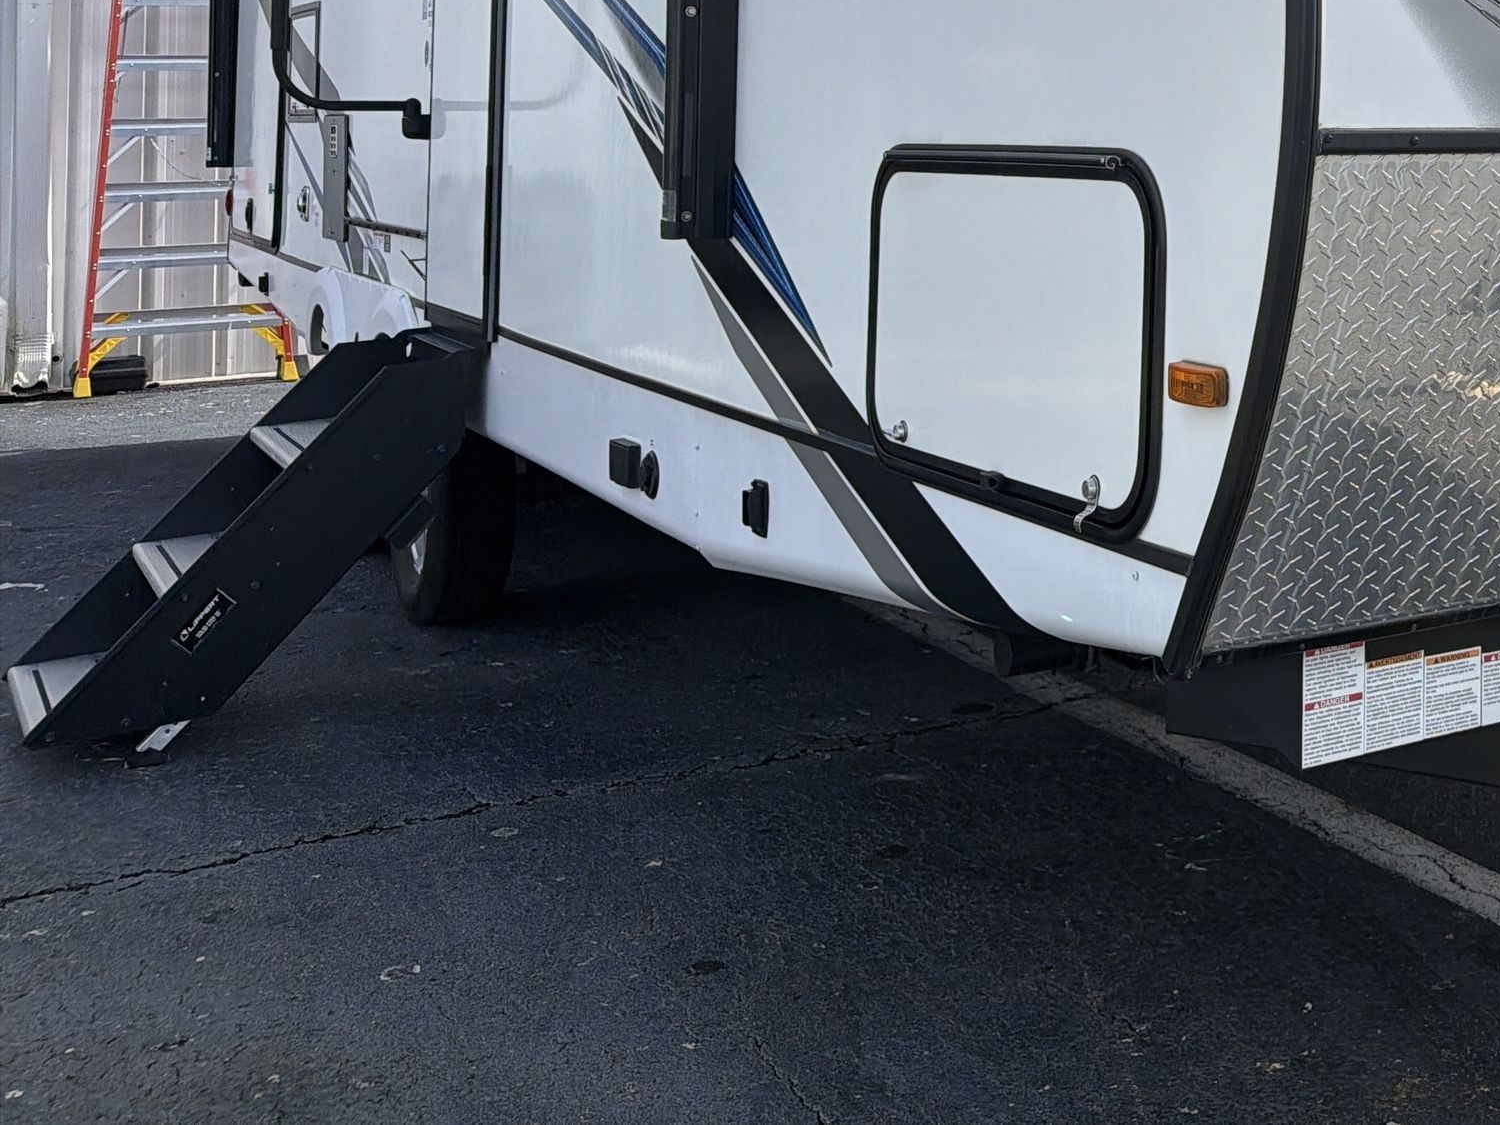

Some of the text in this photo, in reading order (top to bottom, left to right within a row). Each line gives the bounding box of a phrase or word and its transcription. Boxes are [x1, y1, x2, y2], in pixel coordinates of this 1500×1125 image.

[187, 593, 220, 632] LIPPERT
[1440, 651, 1471, 663] WARNING
[1320, 695, 1350, 708] DANGER
